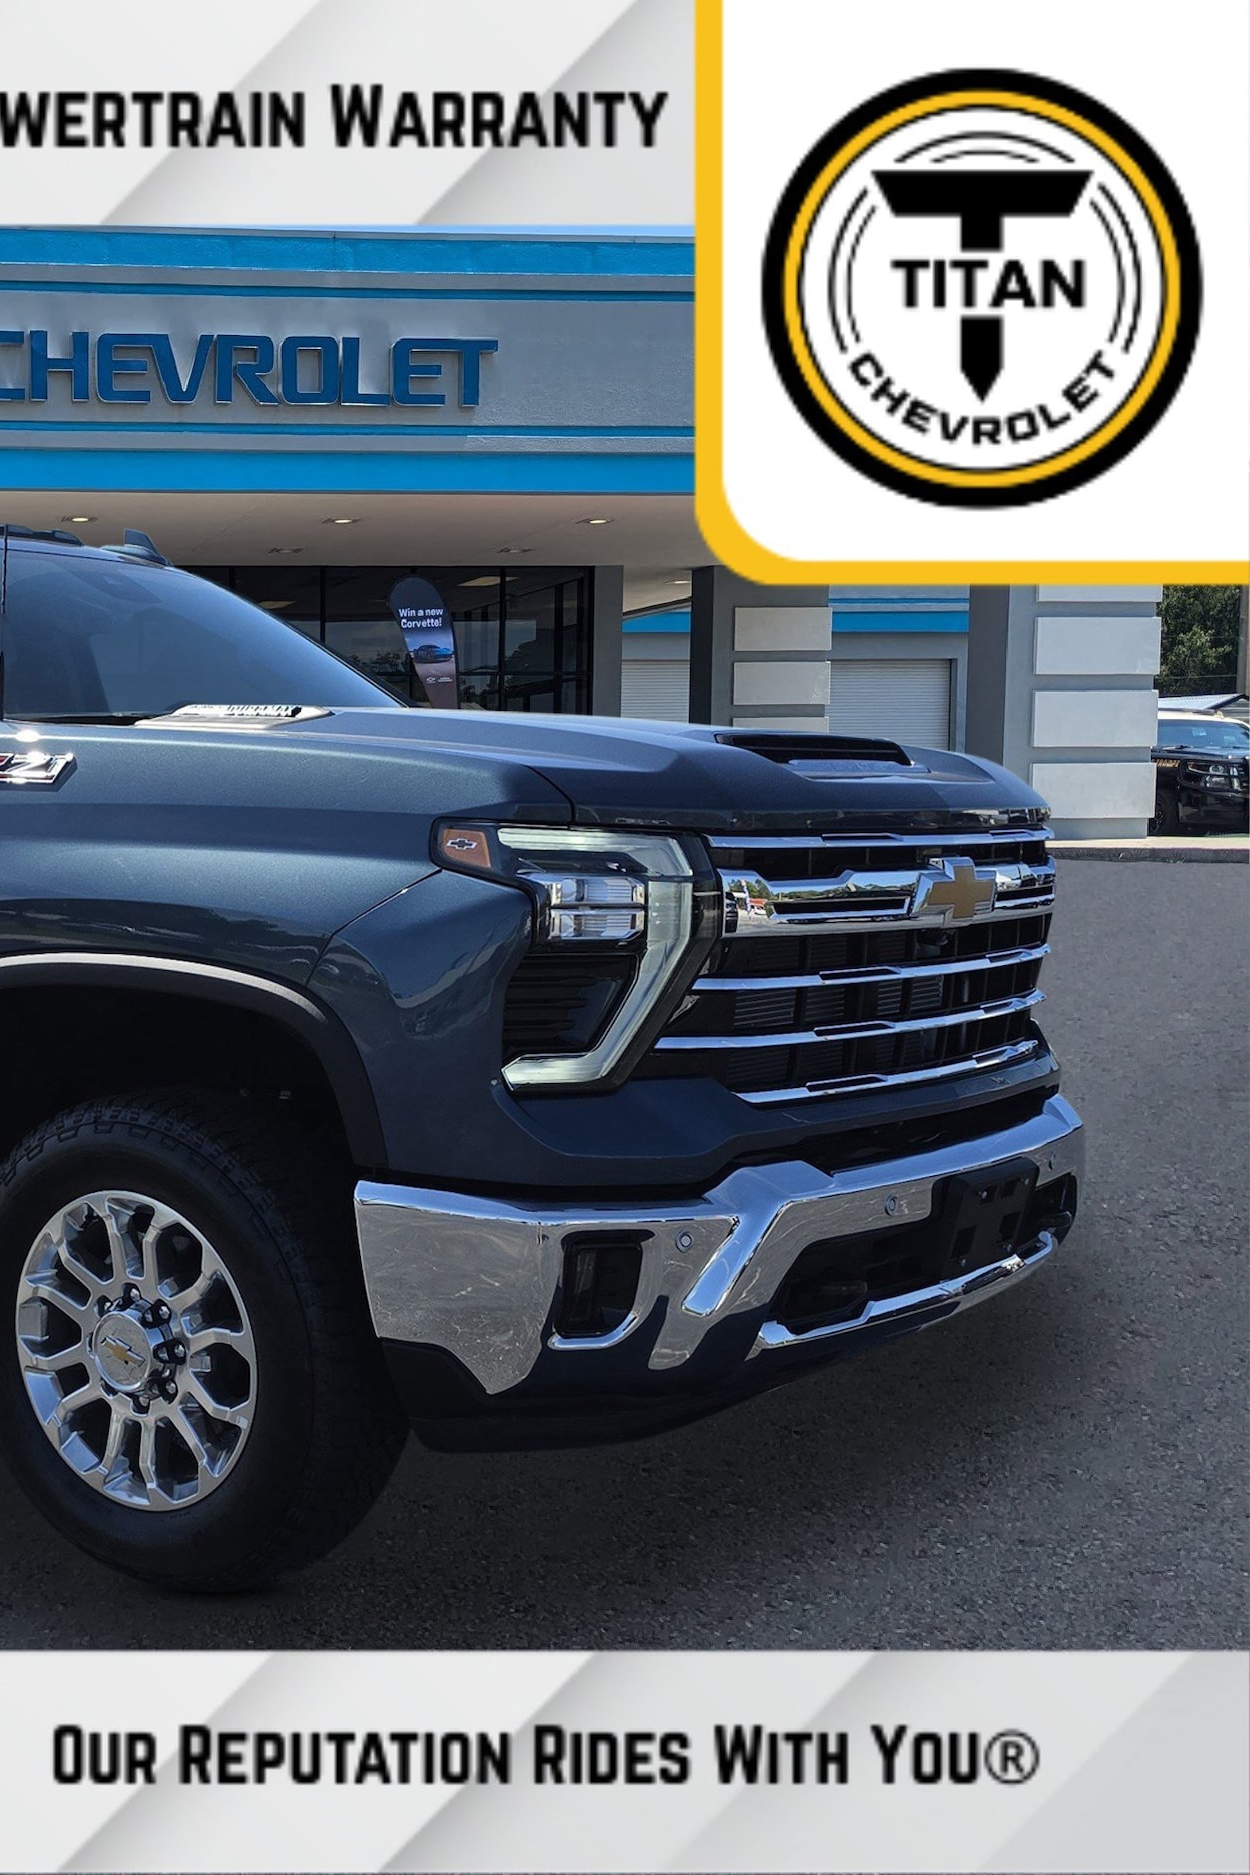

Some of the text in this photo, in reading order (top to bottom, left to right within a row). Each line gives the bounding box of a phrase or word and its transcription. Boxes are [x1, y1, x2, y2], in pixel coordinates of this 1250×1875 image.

[398, 607, 444, 617] Win a new
[400, 617, 442, 629] Corvette!
